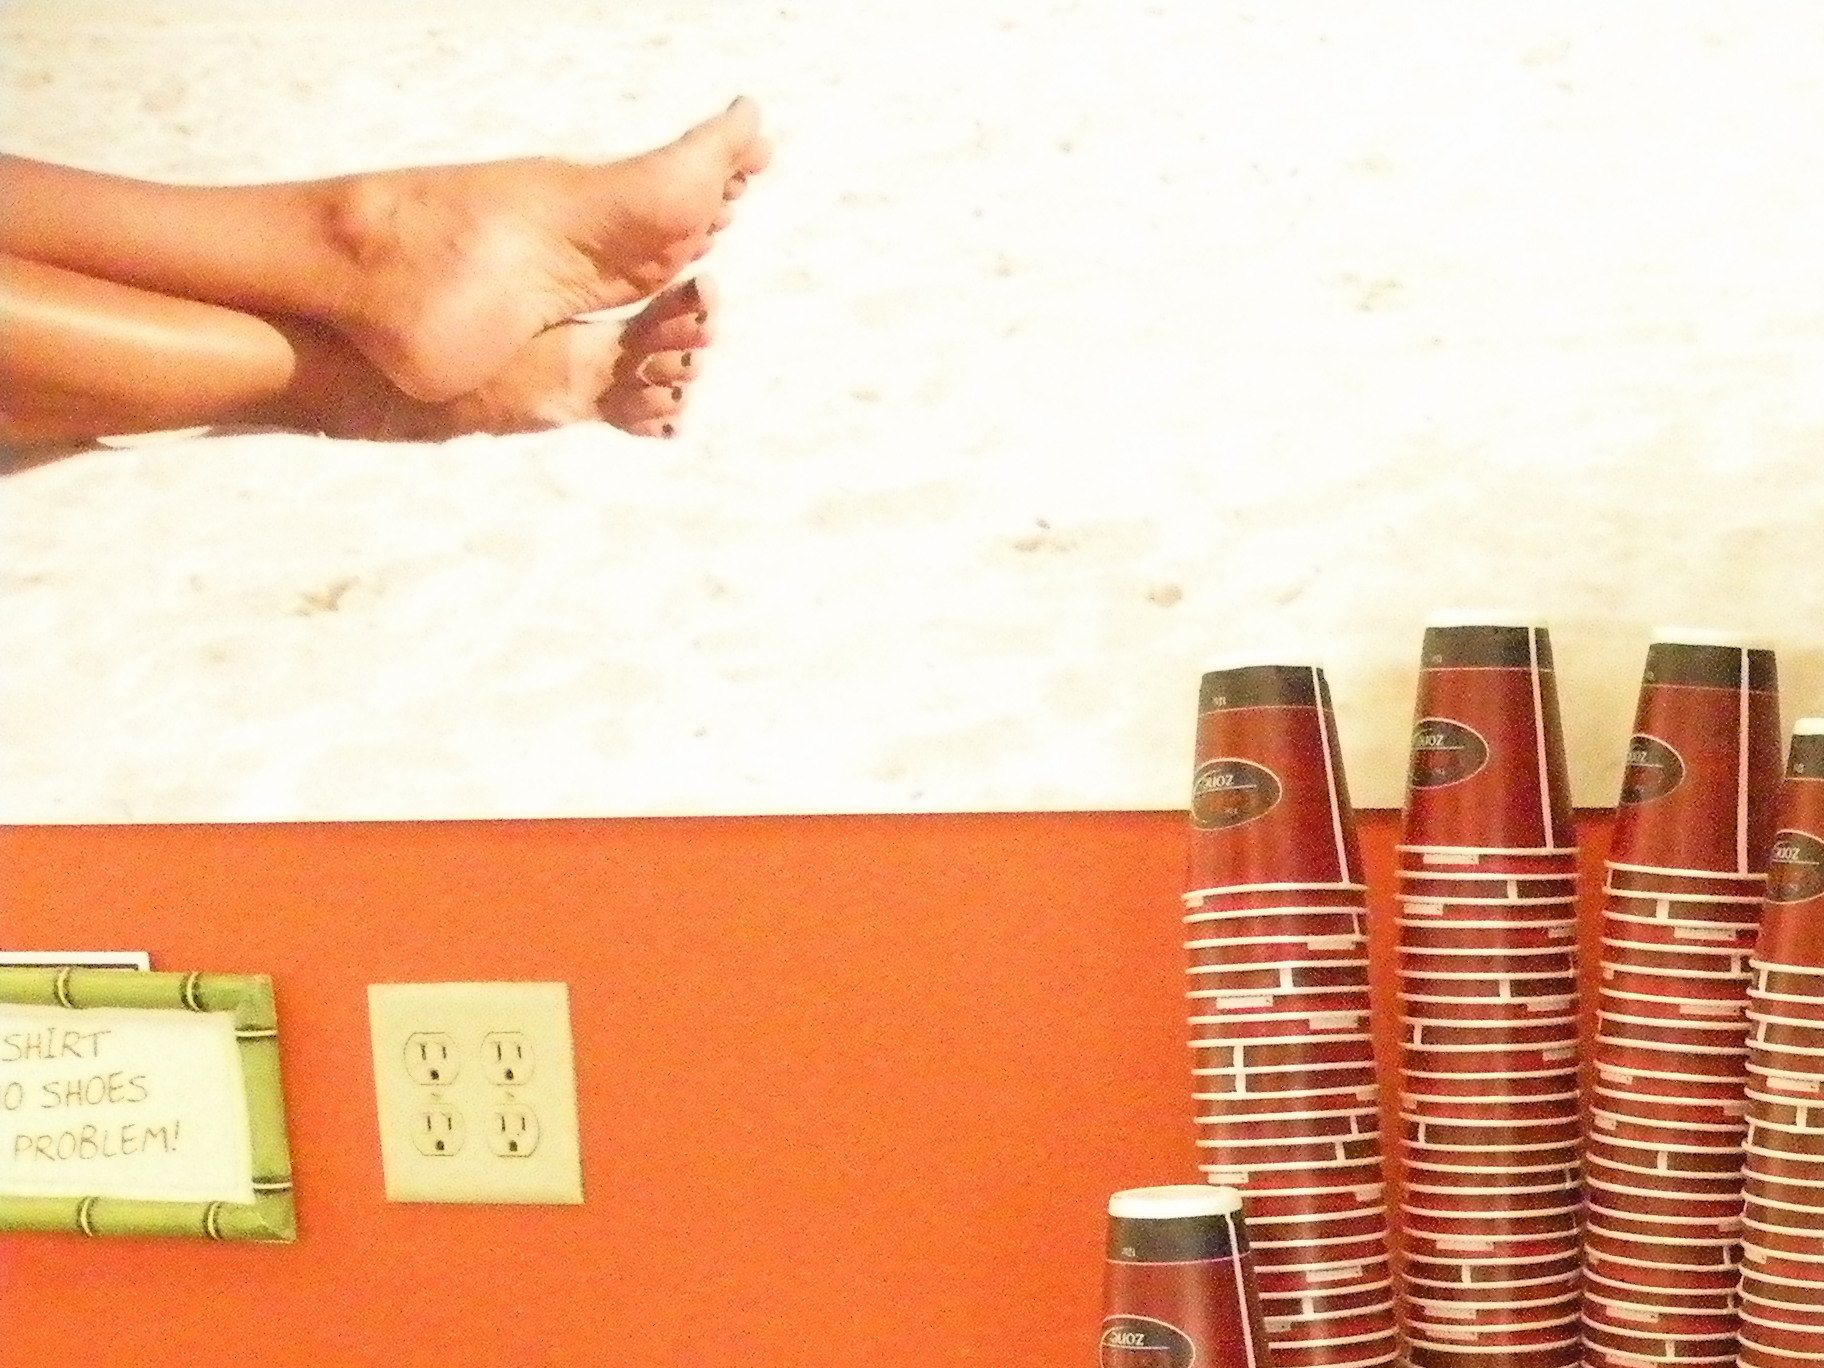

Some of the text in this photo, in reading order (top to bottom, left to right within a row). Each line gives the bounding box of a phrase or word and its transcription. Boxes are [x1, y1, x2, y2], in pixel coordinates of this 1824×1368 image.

[2, 1027, 112, 1062] SHIRT
[41, 1071, 149, 1109] SHOES
[14, 1120, 181, 1162] PROBLEM!
